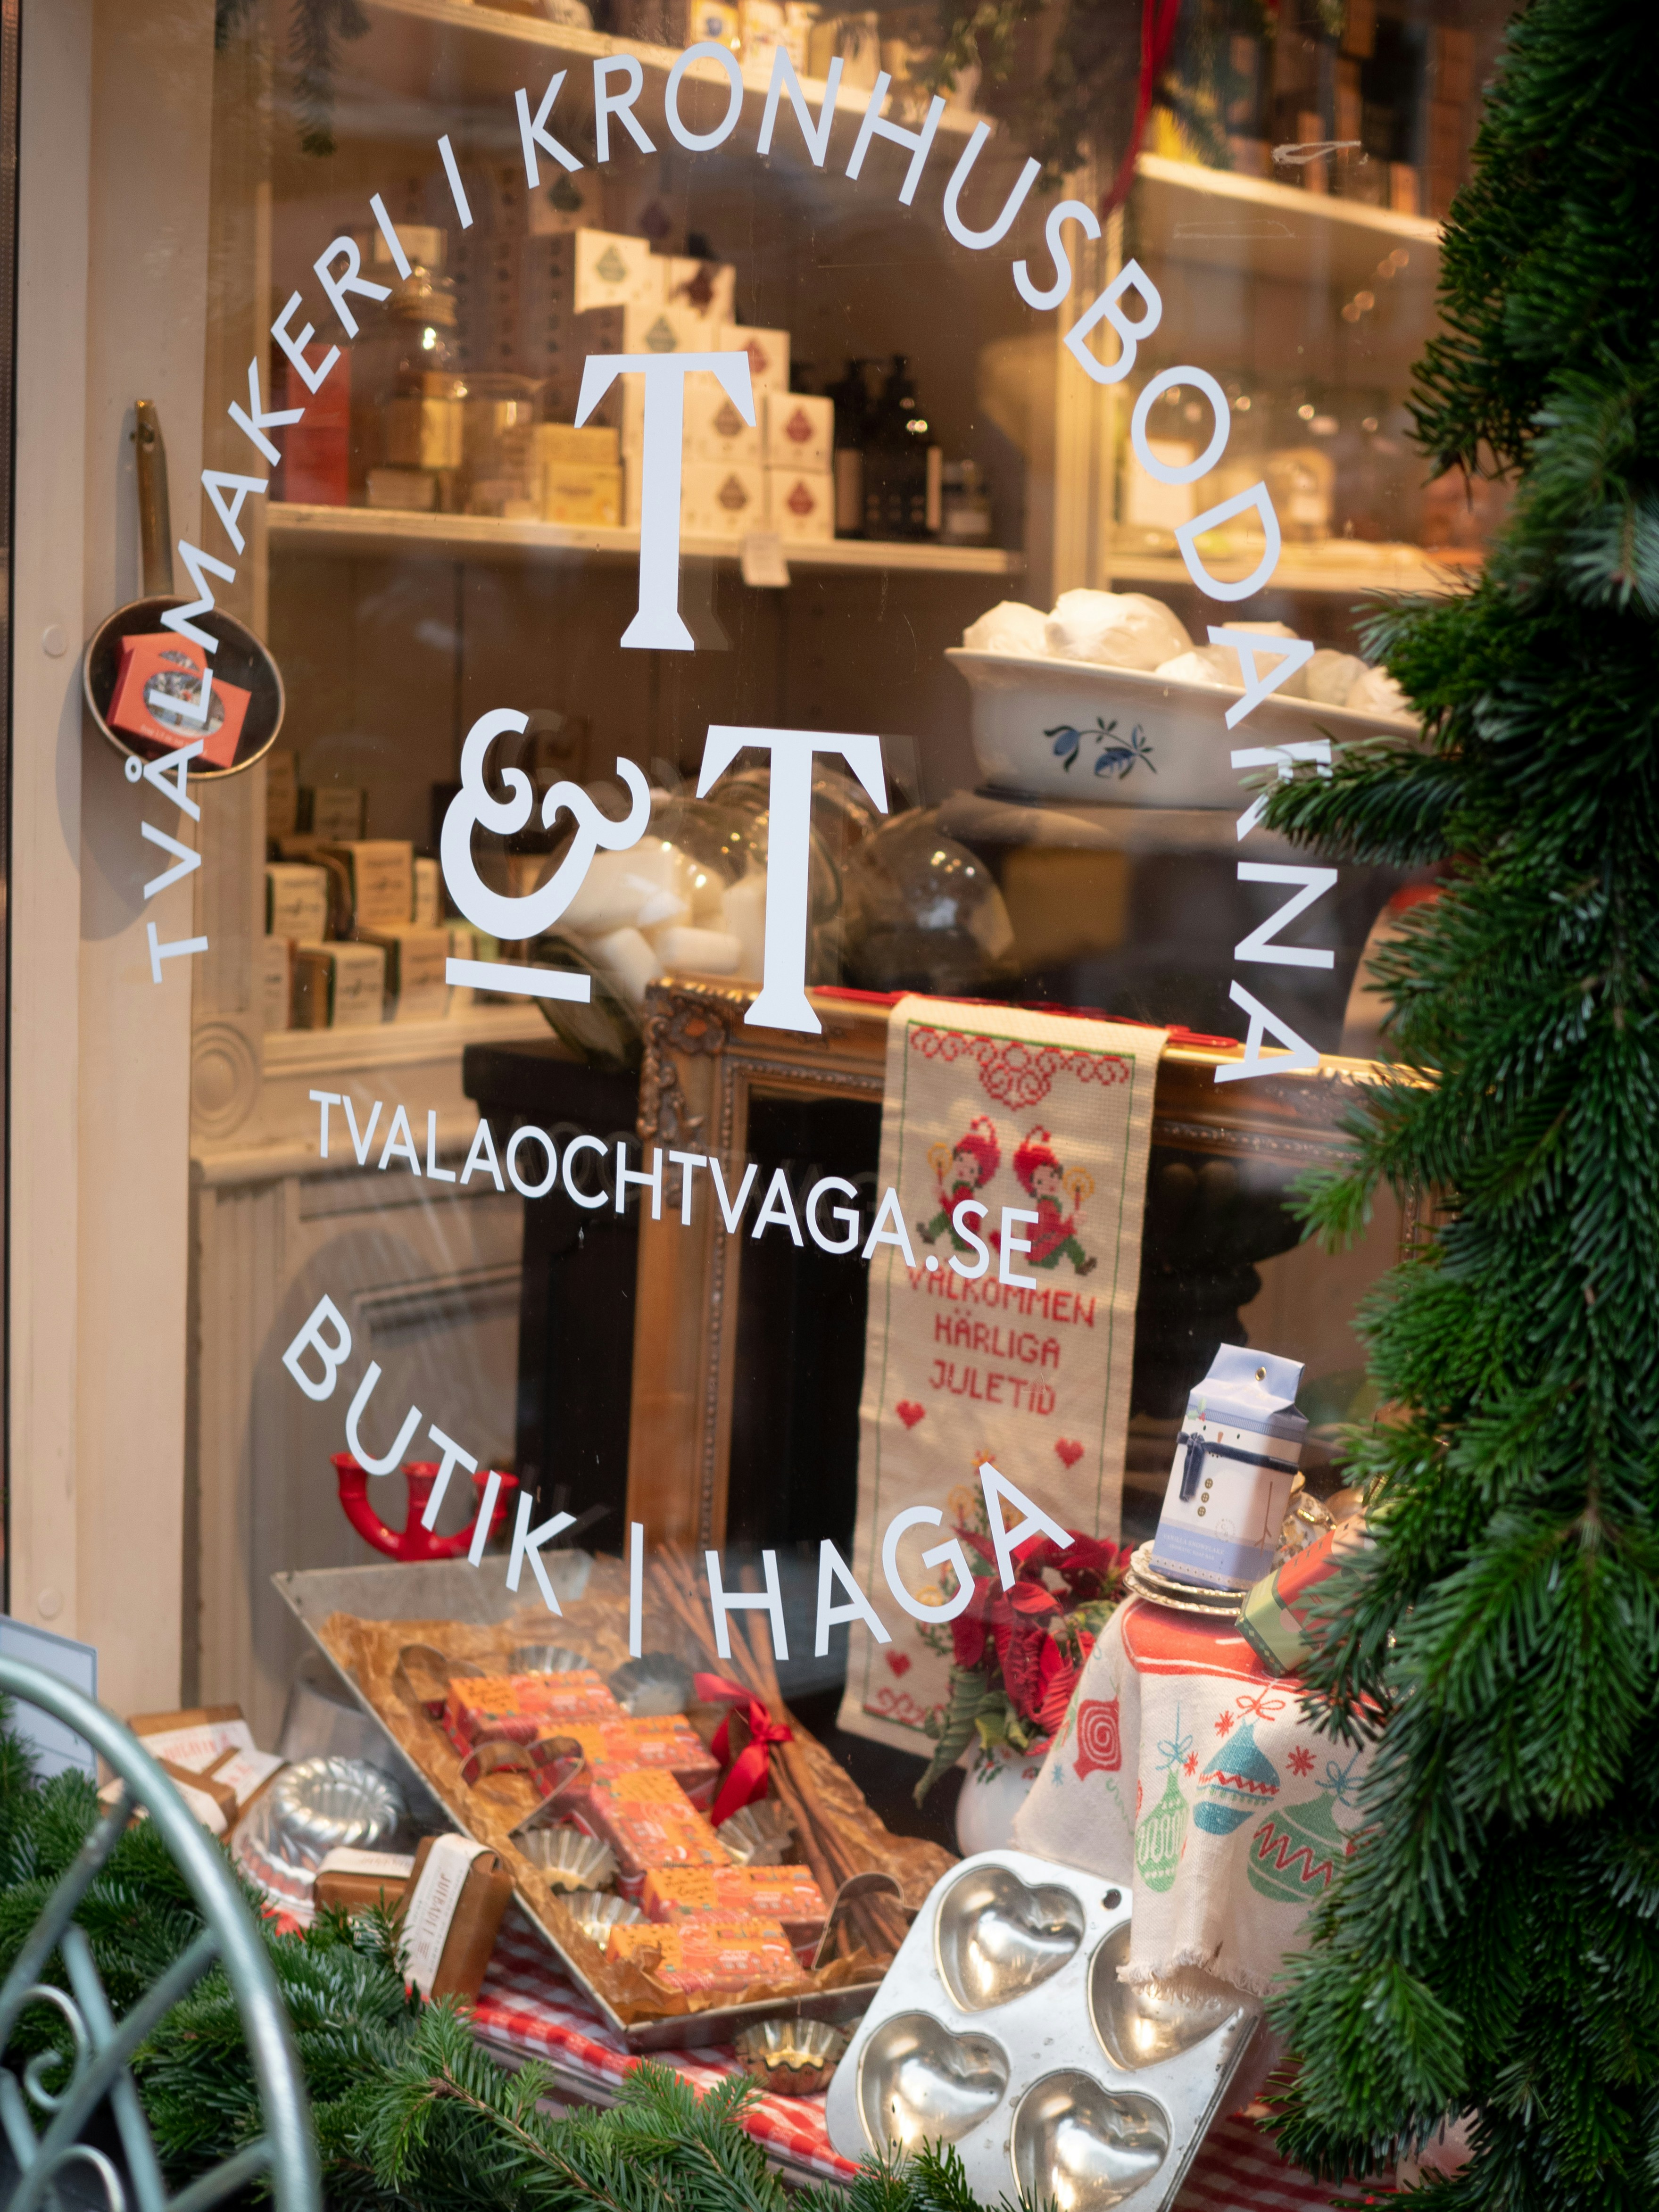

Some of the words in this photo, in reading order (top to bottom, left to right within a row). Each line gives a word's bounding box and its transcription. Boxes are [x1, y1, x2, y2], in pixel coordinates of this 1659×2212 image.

[124, 193, 412, 984] TVÅLMAKERI
[438, 134, 473, 230] I
[574, 351, 756, 651] T
[441, 708, 651, 940] &
[696, 725, 888, 1034] T
[309, 1089, 1039, 1290] TVALAOCHTVAGA.SE
[934, 1307, 1061, 1369] HÄRLIGA
[282, 1293, 577, 1617] BUTIK
[629, 1521, 644, 1658] I
[705, 1461, 1075, 1660] HAGA
[929, 1359, 1057, 1416] JULETID
